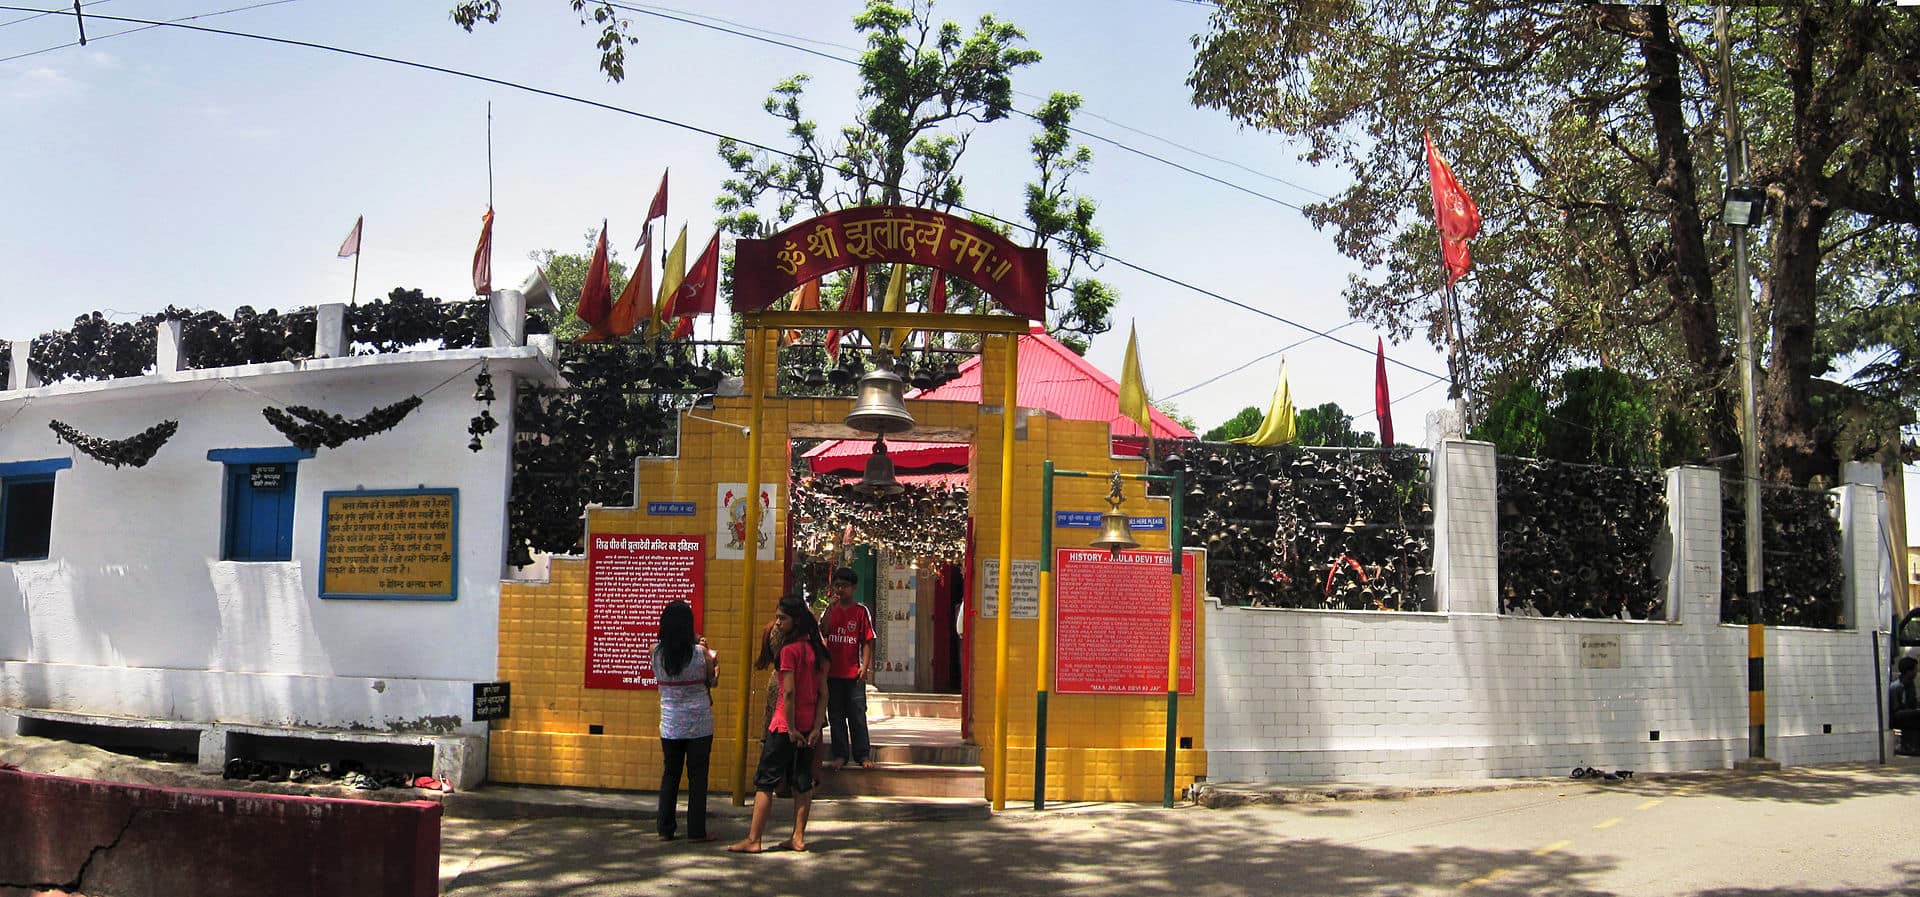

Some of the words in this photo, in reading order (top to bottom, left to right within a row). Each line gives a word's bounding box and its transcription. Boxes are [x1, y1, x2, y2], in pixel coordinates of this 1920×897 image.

[807, 225, 838, 259] श्री
[1070, 553, 1102, 561] HISTORY
[1109, 554, 1133, 563] JULA
[1135, 555, 1152, 563] DEVI
[829, 634, 857, 644] mirates
